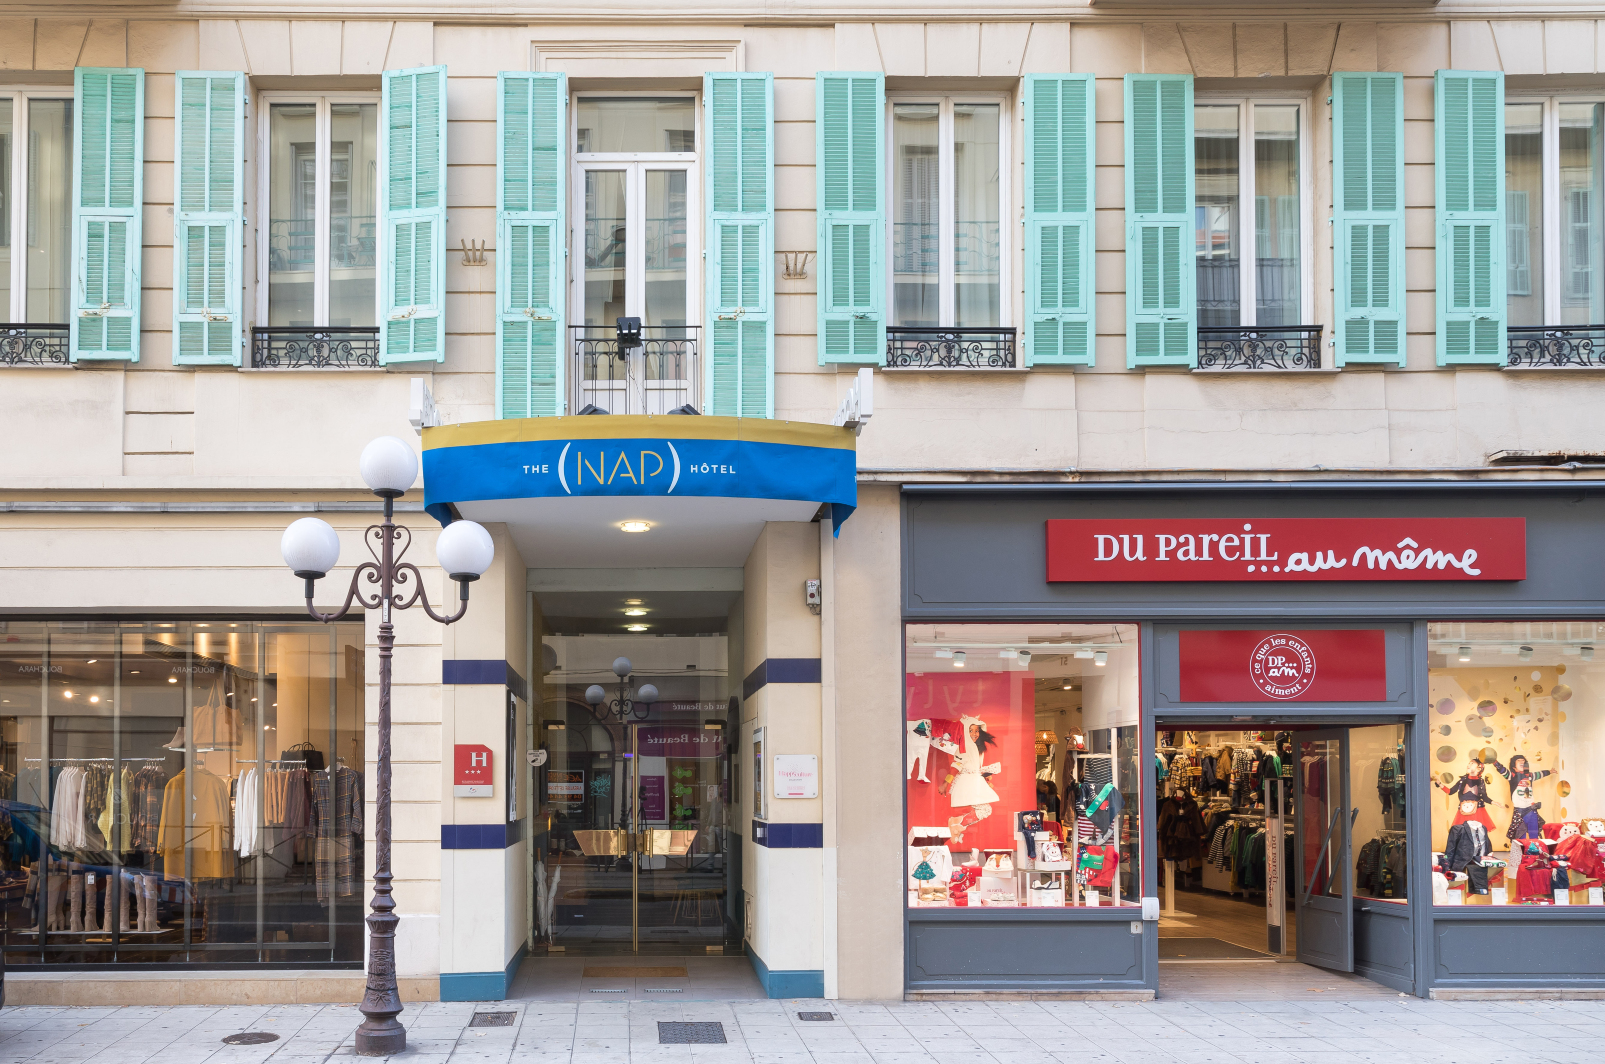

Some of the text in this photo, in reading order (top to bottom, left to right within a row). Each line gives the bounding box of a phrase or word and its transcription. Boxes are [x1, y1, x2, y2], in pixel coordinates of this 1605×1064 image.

[522, 464, 549, 474] THE
[690, 462, 737, 475] HÔTEL
[1351, 536, 1482, 576] même
[1254, 638, 1313, 674] ce que les enfants
[1268, 666, 1299, 677] am
[1264, 683, 1302, 696] aiment
[470, 752, 488, 767] H
